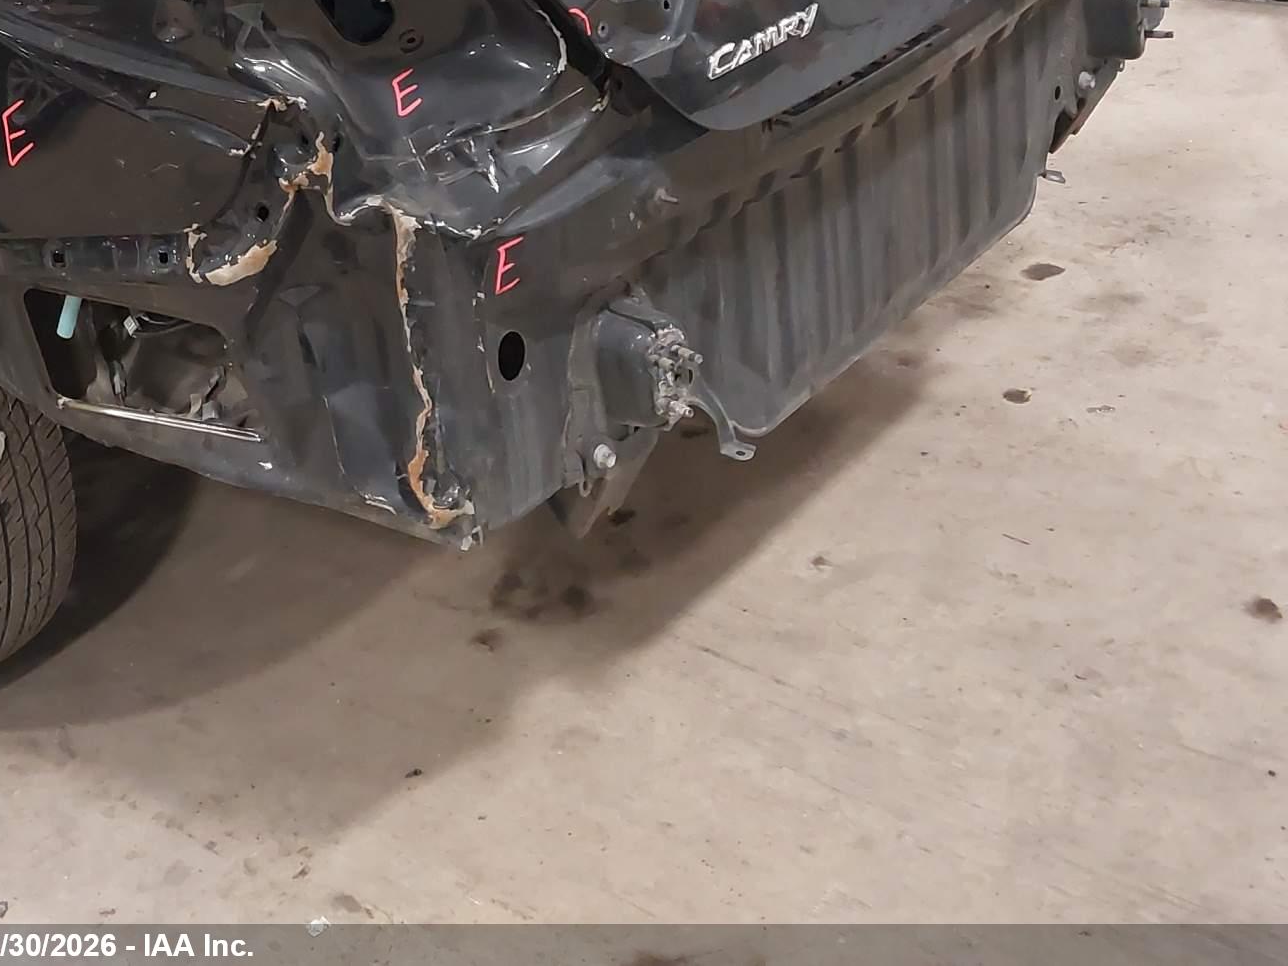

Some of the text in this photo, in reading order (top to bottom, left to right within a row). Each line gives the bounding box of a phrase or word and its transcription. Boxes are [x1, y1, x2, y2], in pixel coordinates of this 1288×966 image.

[707, 2, 819, 80] CAMRY
[393, 69, 422, 117] E
[1, 99, 35, 167] E
[495, 237, 523, 294] E
